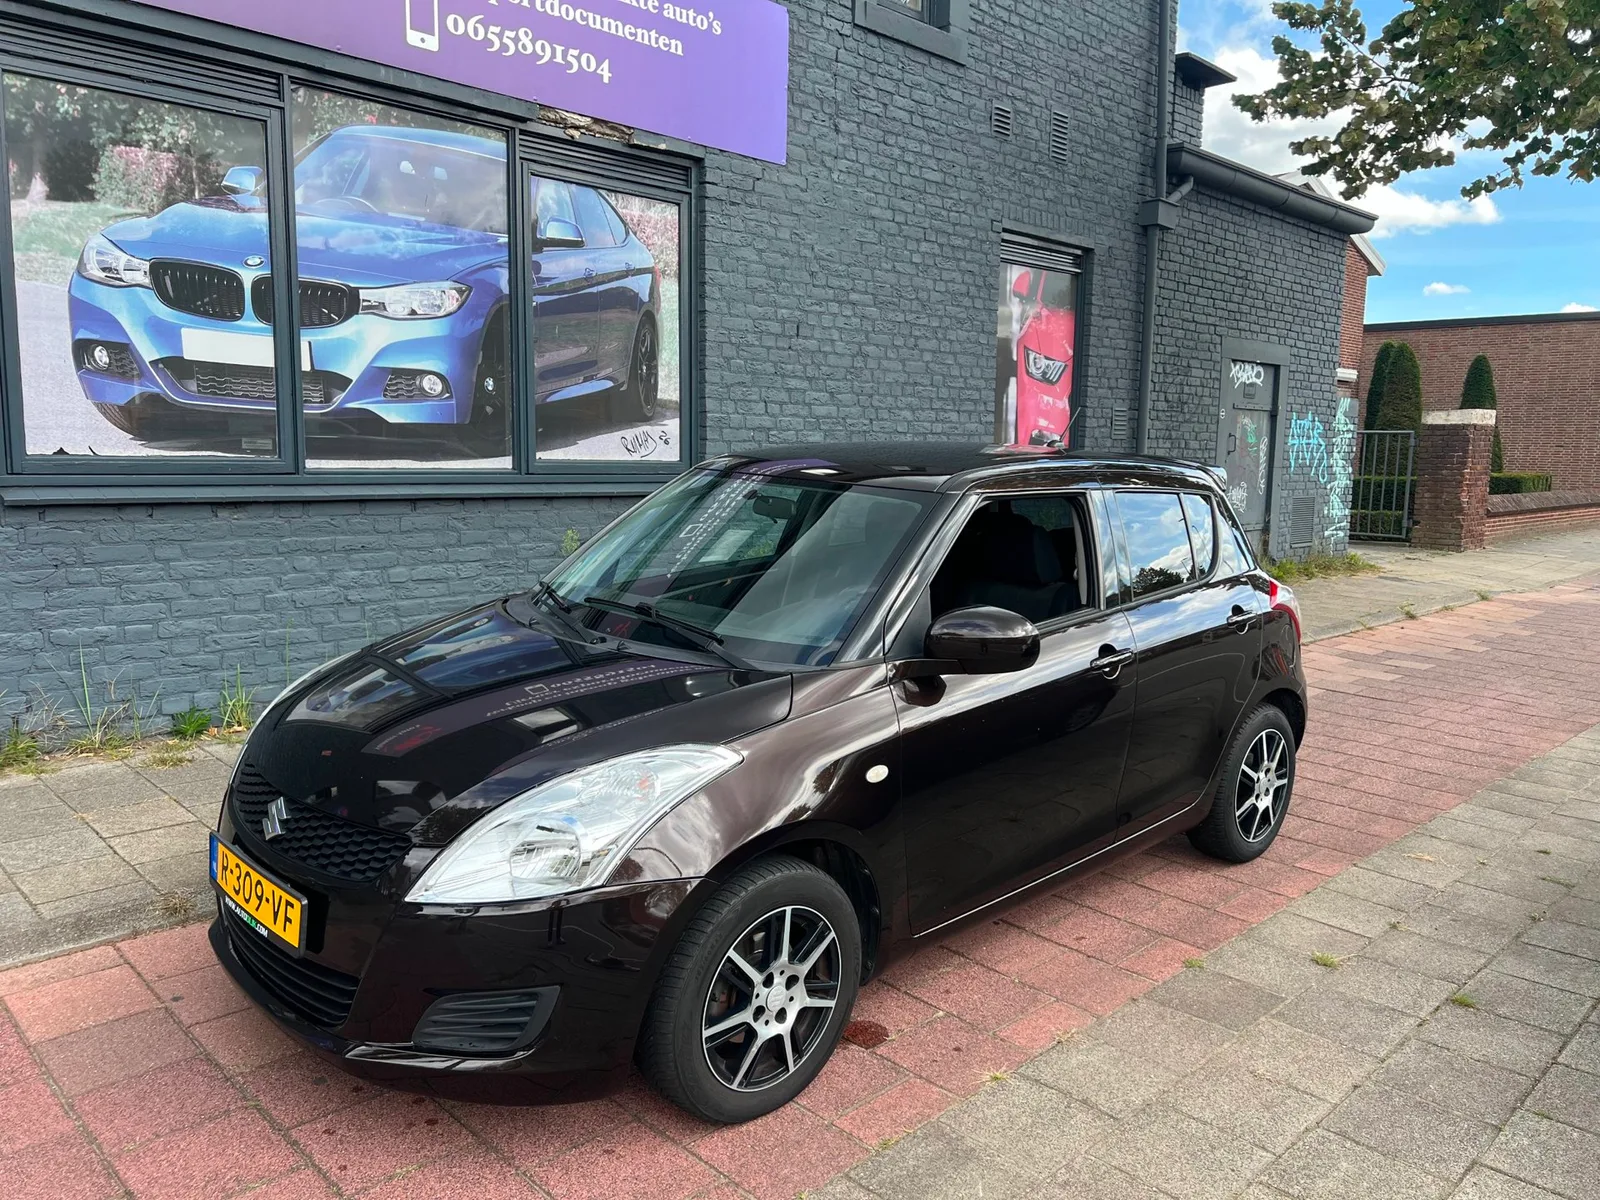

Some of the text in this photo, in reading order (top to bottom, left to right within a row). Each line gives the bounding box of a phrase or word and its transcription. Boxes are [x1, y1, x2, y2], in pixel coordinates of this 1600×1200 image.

[446, 14, 613, 84] 0655891504
[662, 3, 723, 36] auto's
[220, 851, 295, 933] R-309-VF
